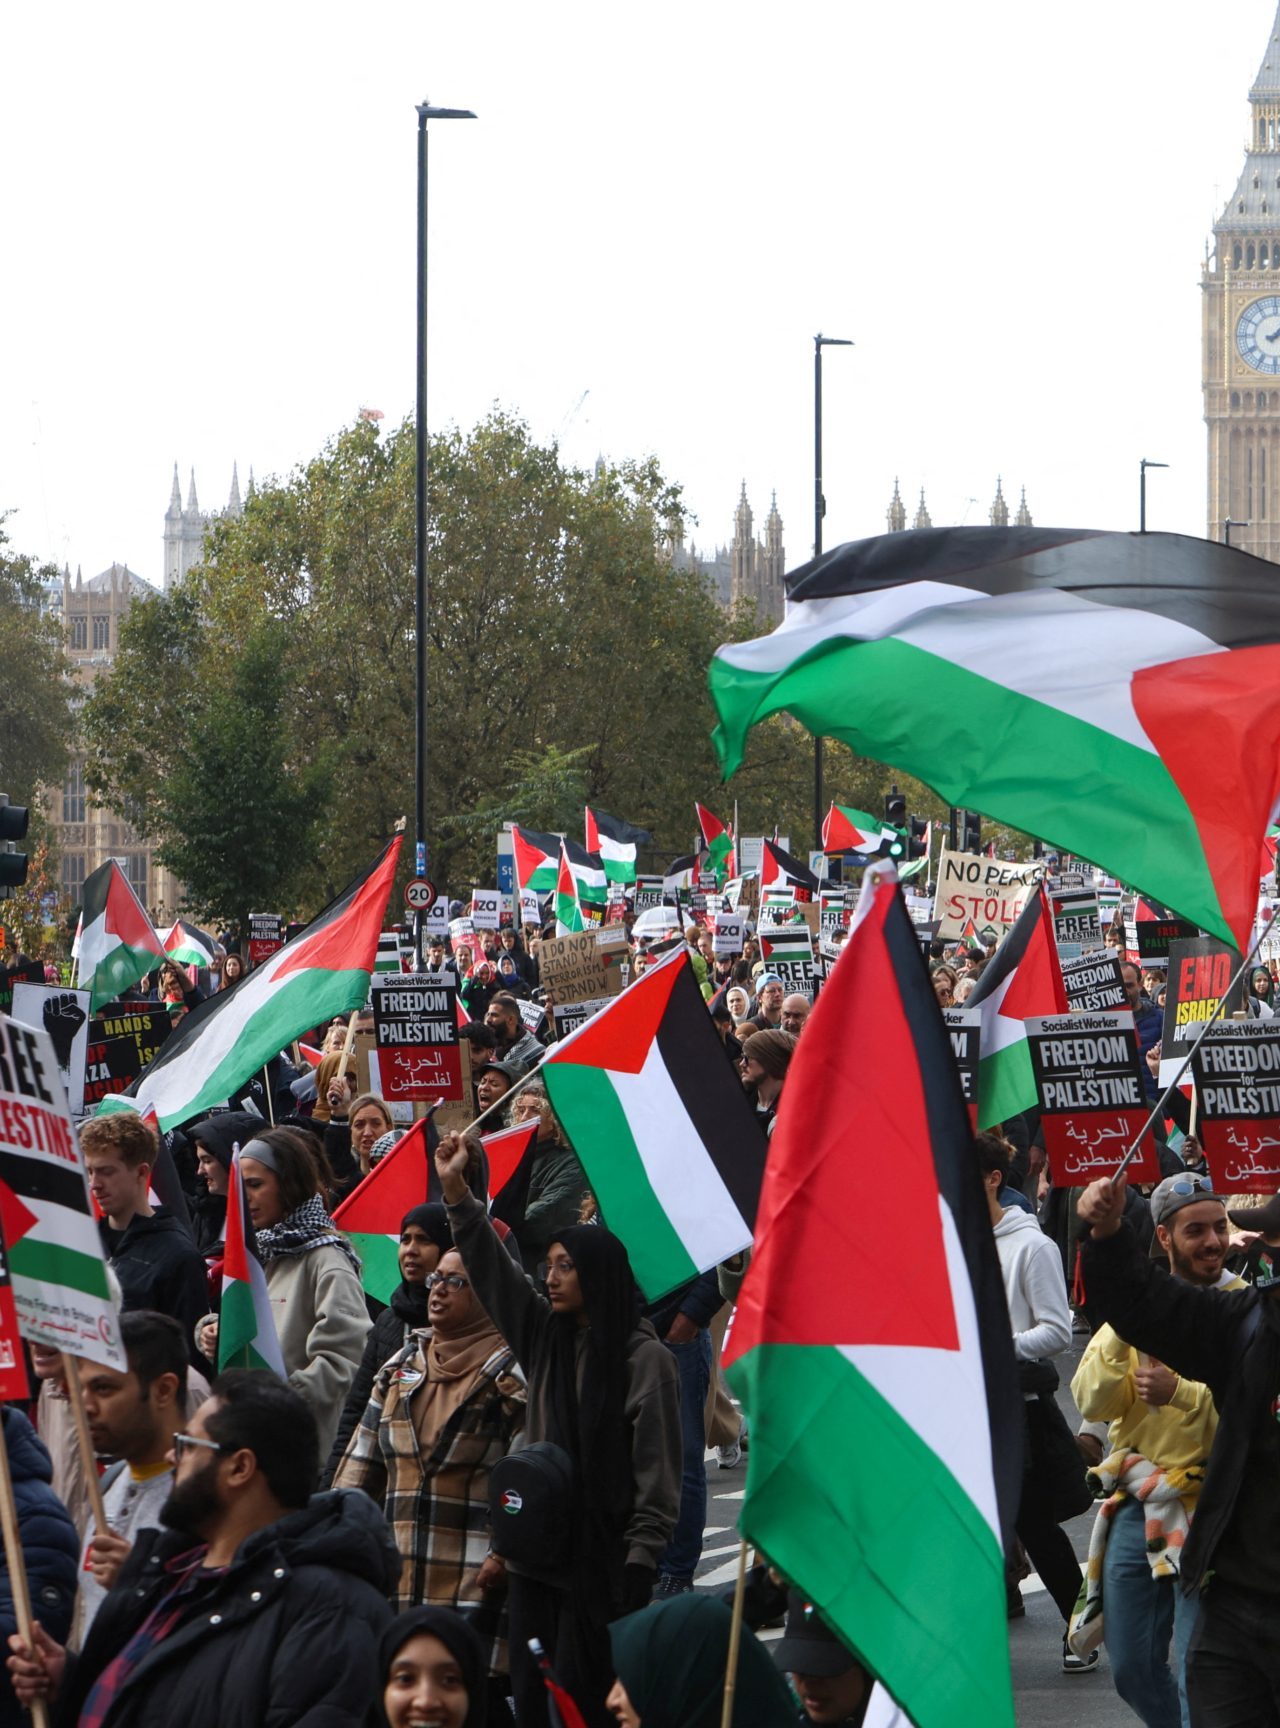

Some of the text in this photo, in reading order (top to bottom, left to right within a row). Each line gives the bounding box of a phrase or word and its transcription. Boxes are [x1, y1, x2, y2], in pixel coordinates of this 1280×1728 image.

[946, 859, 980, 883] NO
[1069, 862, 1094, 873] FREE
[409, 888, 429, 901] 20
[636, 892, 662, 903] FREE
[986, 888, 999, 897] ON
[427, 906, 444, 918] za
[480, 900, 497, 912] za
[948, 895, 1022, 922] STOLE
[720, 925, 740, 936] za
[1055, 914, 1099, 934] FREE
[551, 941, 565, 955] DO
[569, 936, 595, 951] NOT
[1056, 929, 1101, 942] PALESTINE
[543, 953, 577, 974] STAND
[764, 961, 814, 981] FREE
[784, 981, 815, 992] ESTINE
[1063, 963, 1116, 992] FREEDOM
[1178, 953, 1232, 1001] END
[559, 982, 596, 1002] STAND
[1068, 987, 1126, 1012] PALESTINE
[1086, 985, 1097, 994] for
[380, 991, 448, 1012] FREEDOM
[104, 1015, 152, 1035] HANDS
[409, 1012, 420, 1021] for
[379, 1022, 454, 1043] PALESTINE
[394, 1051, 442, 1071] الحرية
[1039, 1036, 1129, 1067] FREEDOM
[85, 1063, 111, 1082] ZA
[390, 1071, 451, 1091] لفلسطين
[1080, 1066, 1095, 1079] for
[1240, 1072, 1255, 1086] for
[1042, 1077, 1141, 1109] PALESTINE
[0, 1099, 78, 1163] ESTINE
[1065, 1117, 1130, 1145] الحرية
